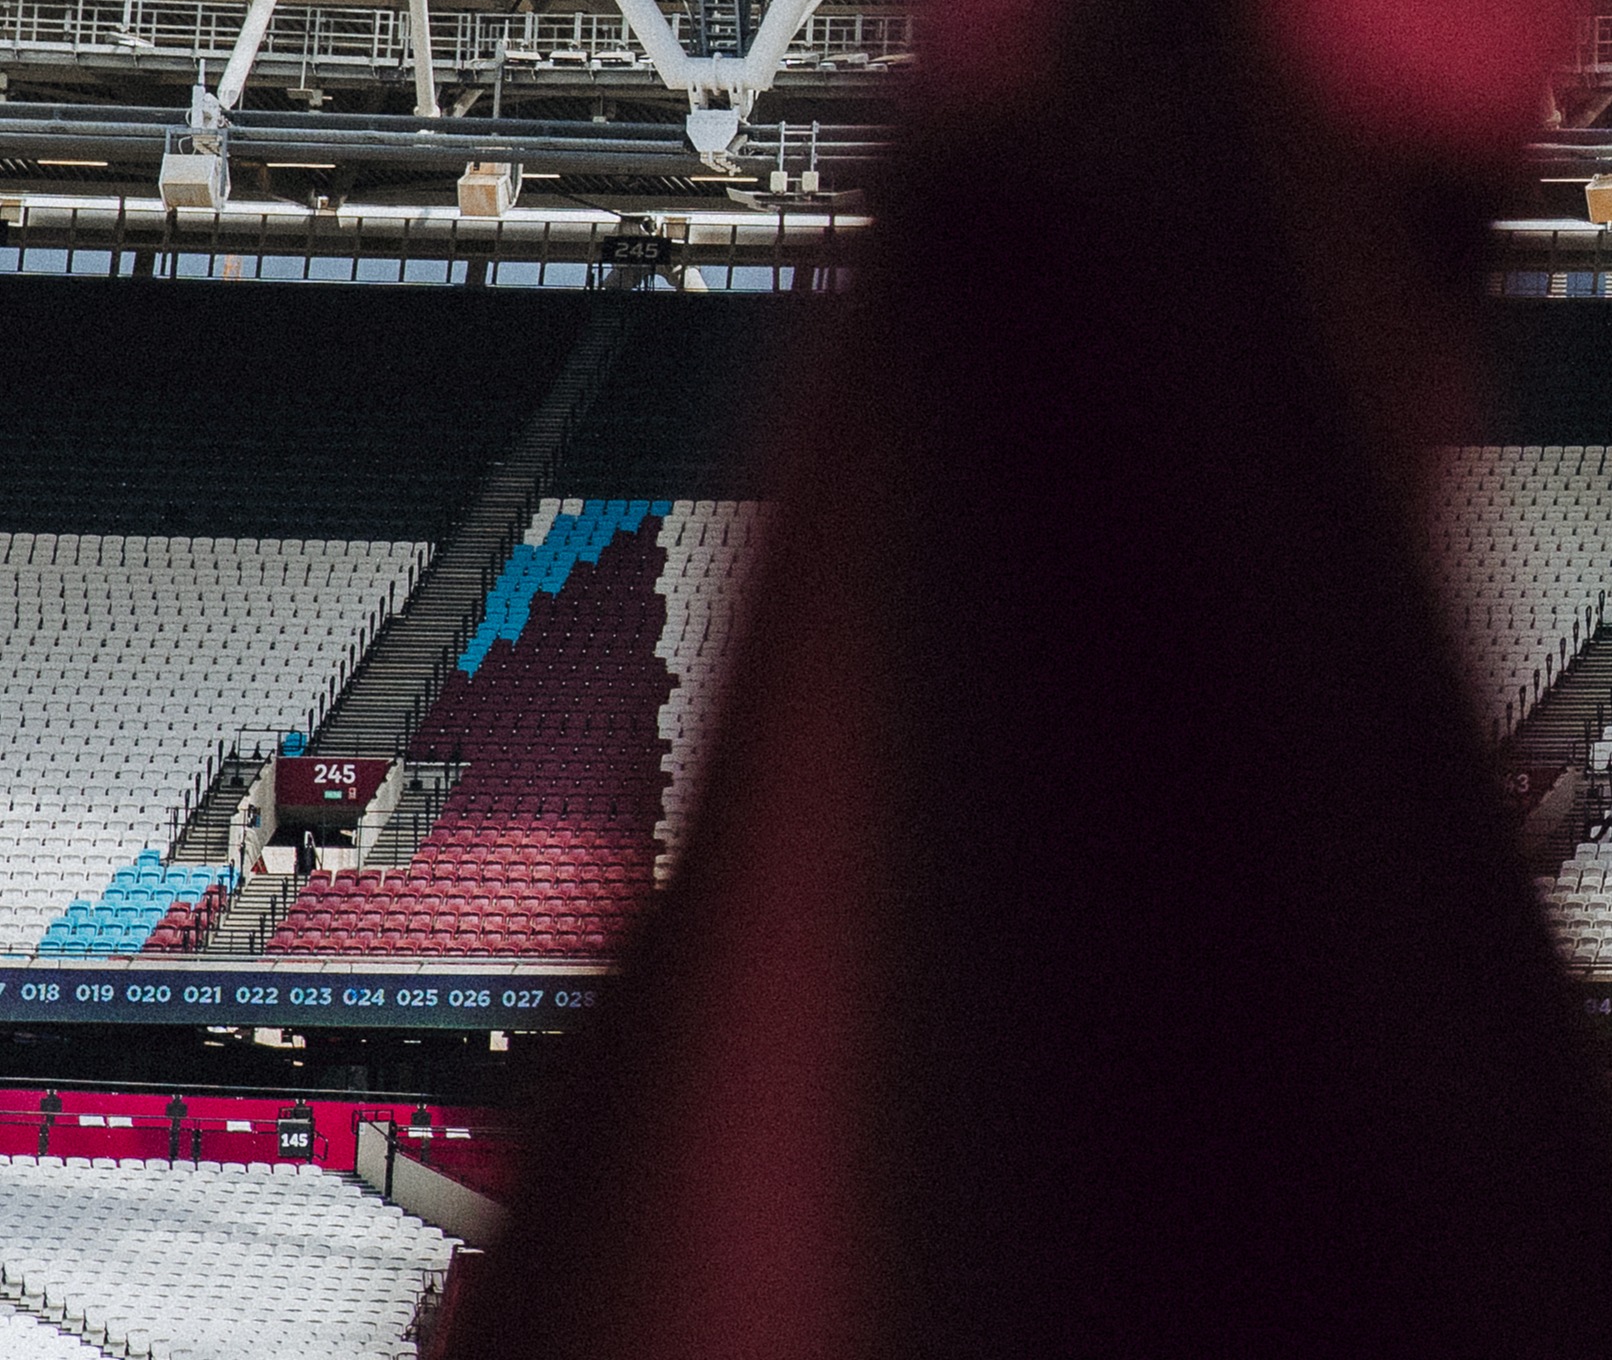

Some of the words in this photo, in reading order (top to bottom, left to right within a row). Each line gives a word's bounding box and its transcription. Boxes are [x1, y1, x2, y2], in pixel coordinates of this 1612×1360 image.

[614, 242, 658, 258] 245
[314, 764, 356, 784] 245
[20, 983, 60, 1002] 018
[75, 984, 115, 1002] 019
[126, 985, 172, 1003] 020
[183, 986, 222, 1004] 021
[235, 987, 279, 1005] 022
[290, 987, 333, 1006] 023
[343, 988, 385, 1006] 024
[396, 989, 438, 1007] 025
[448, 990, 491, 1008] 026
[502, 990, 544, 1008] 027
[281, 1133, 308, 1147] 145
